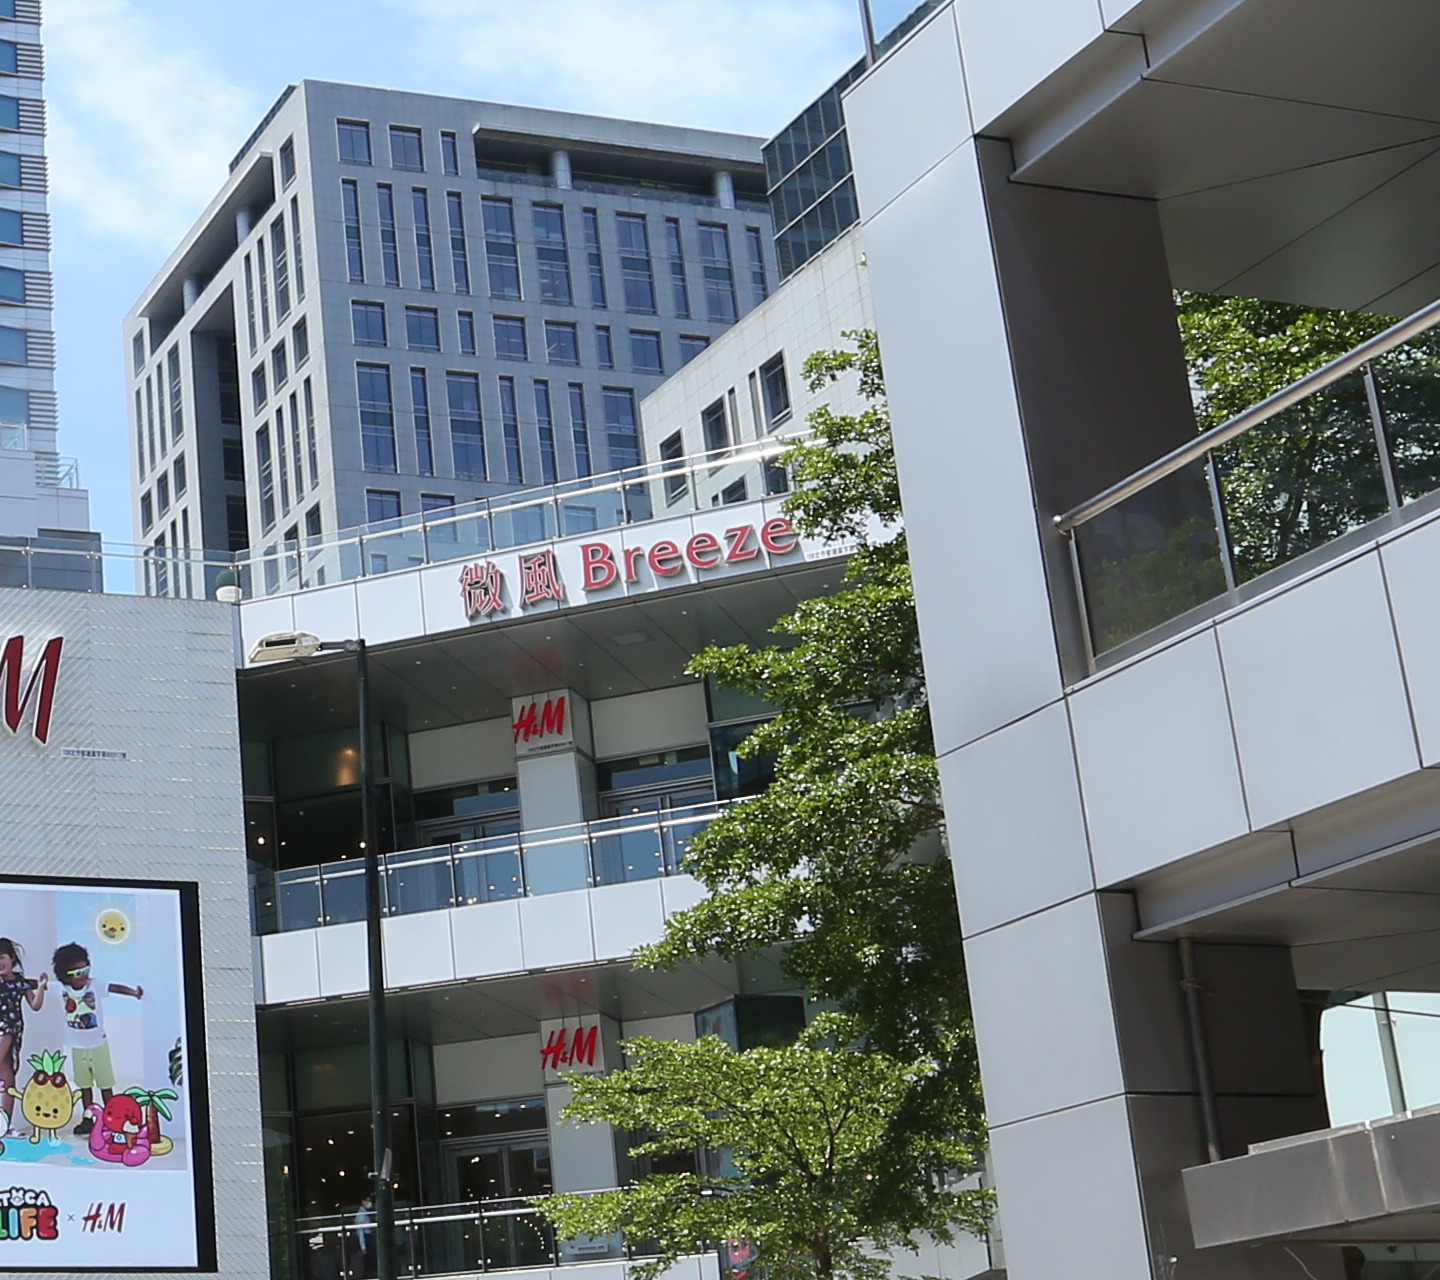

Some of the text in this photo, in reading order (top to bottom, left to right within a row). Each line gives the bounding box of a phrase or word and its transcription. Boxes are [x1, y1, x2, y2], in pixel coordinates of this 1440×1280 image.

[459, 516, 798, 618] 微風 Breeze
[511, 697, 566, 744] H&M
[540, 1025, 599, 1071] H&M
[82, 1202, 126, 1234] H&M
